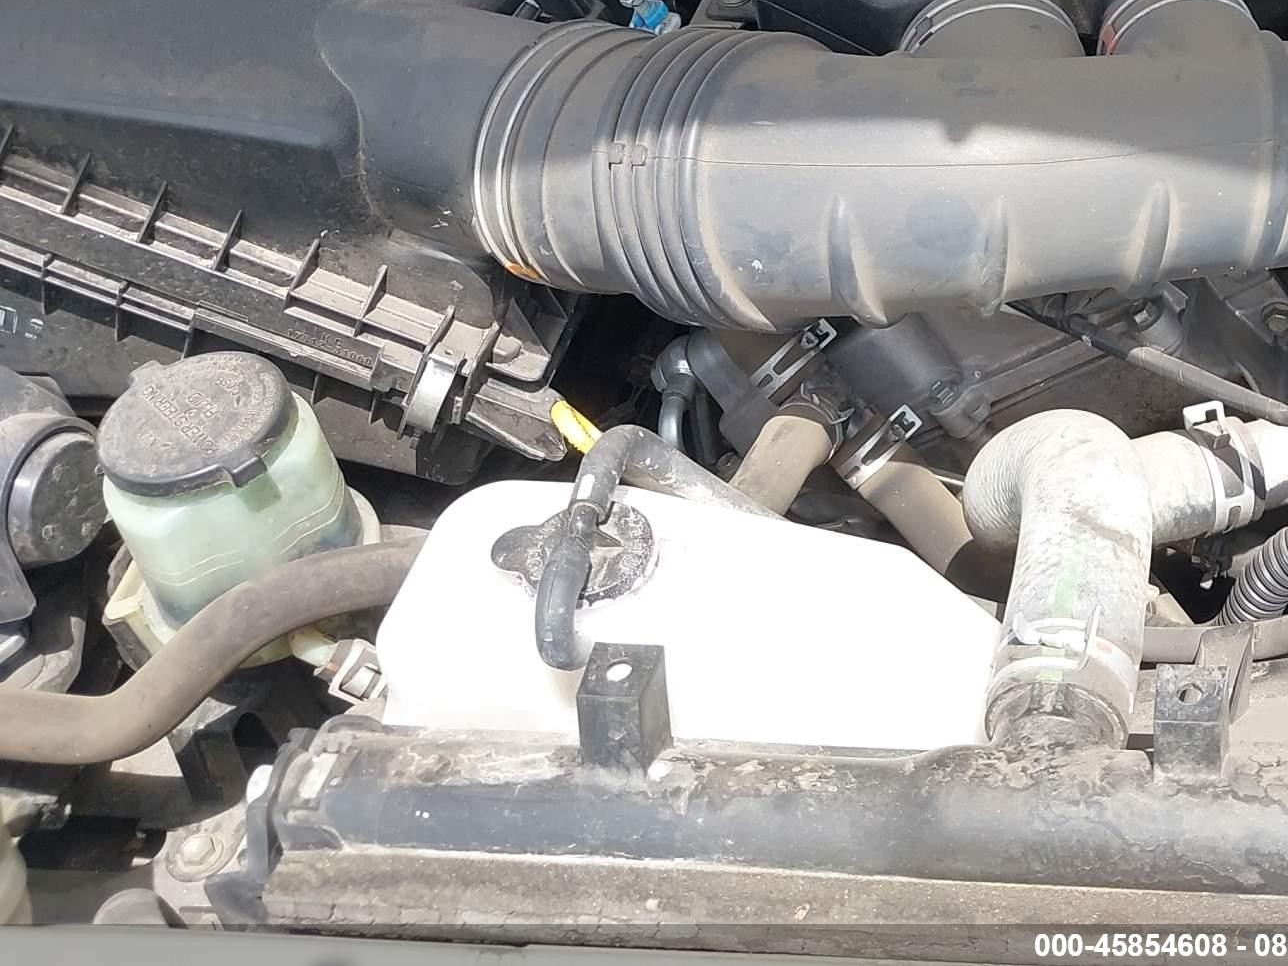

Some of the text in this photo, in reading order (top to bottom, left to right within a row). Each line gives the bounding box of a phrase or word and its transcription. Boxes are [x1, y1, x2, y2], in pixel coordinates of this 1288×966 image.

[142, 384, 189, 429] STEERING
[186, 391, 218, 420] FLUID
[180, 422, 220, 456] POWER
